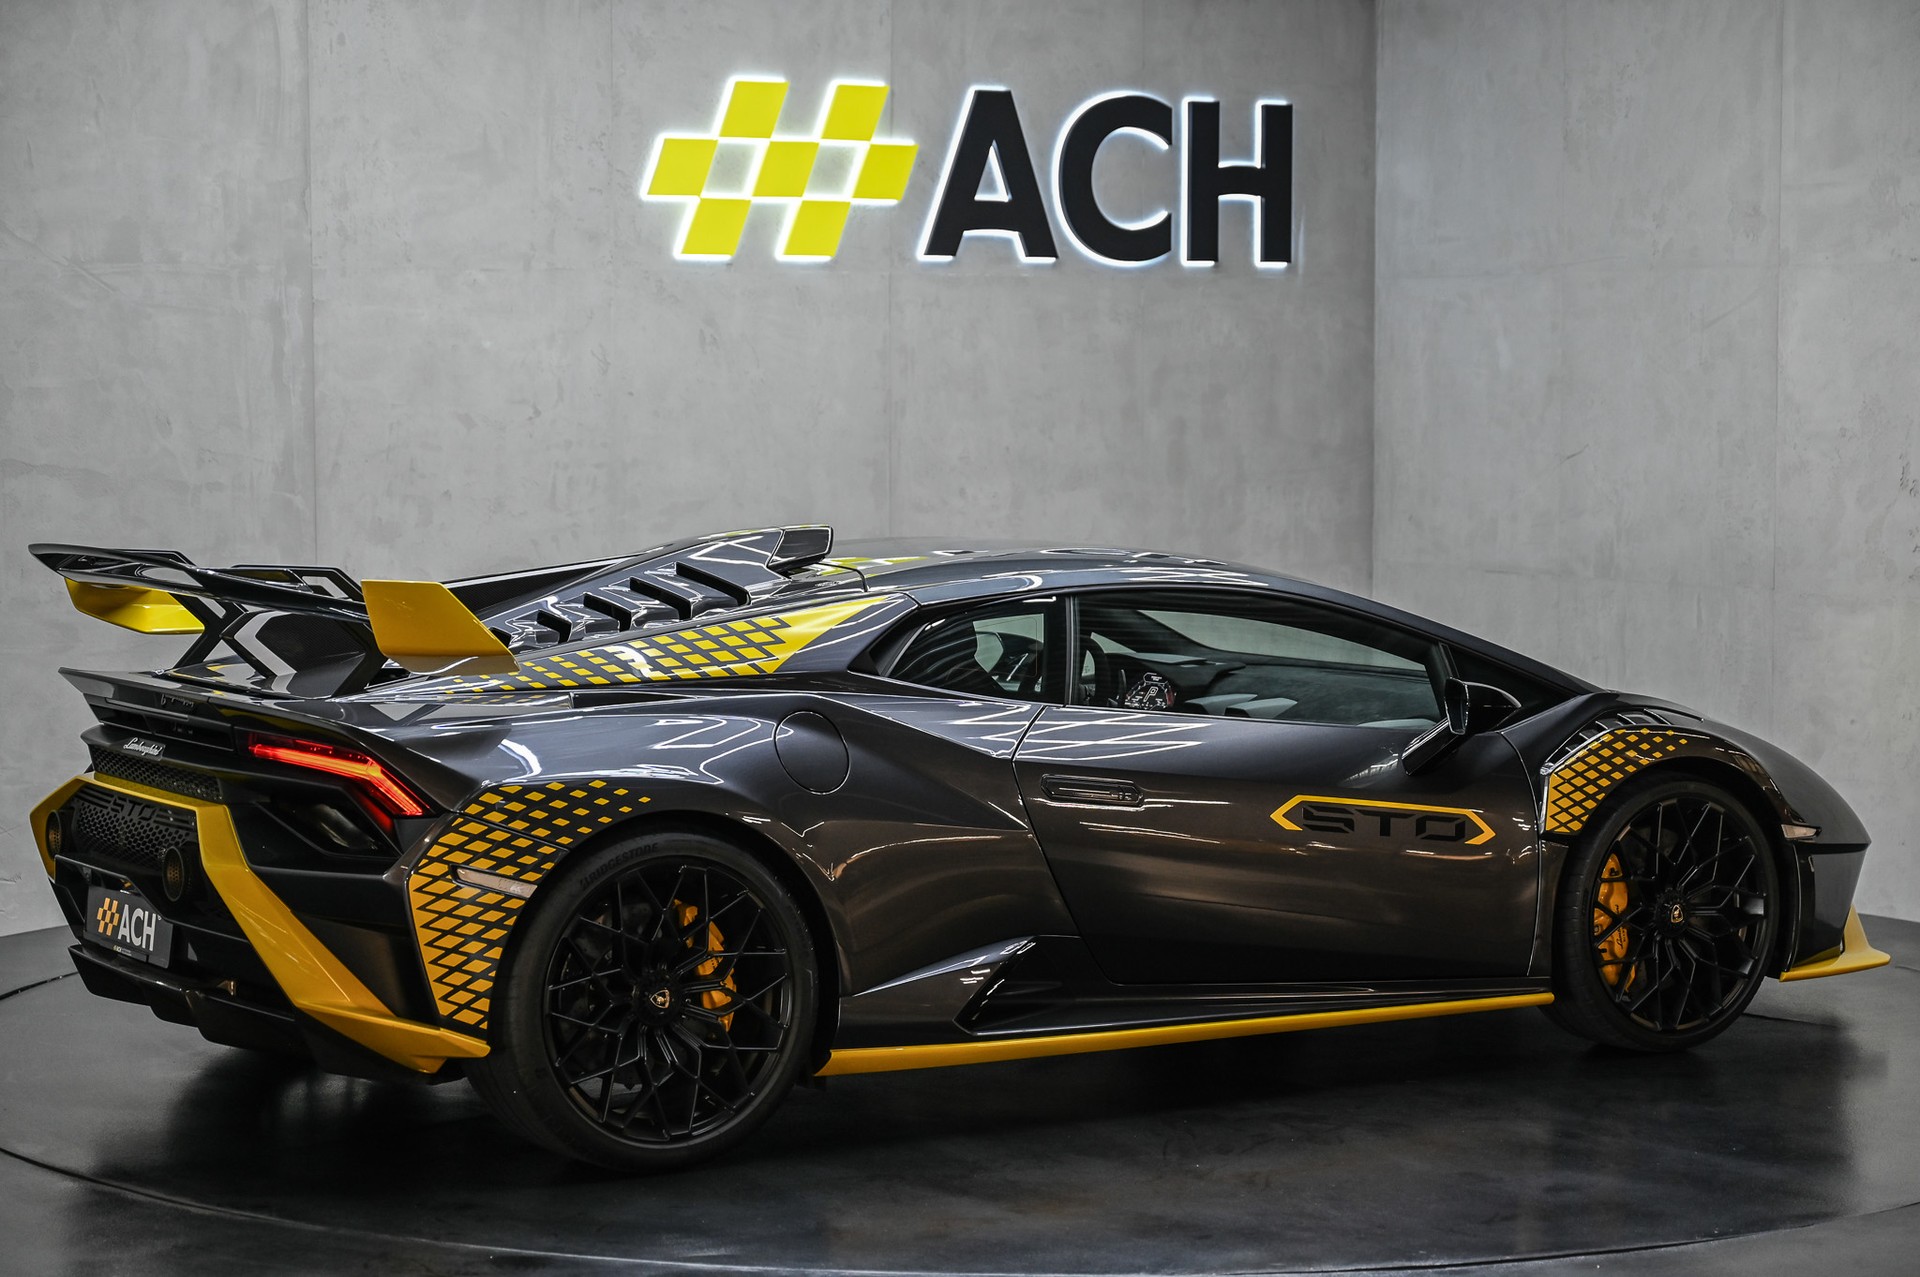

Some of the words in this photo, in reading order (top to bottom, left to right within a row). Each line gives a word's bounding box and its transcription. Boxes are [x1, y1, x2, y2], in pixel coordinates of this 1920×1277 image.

[922, 88, 1293, 265] ACH
[111, 796, 157, 822] STO
[1302, 804, 1466, 842] STO
[580, 842, 659, 890] BRIDGESTONE
[117, 903, 157, 952] ACH
